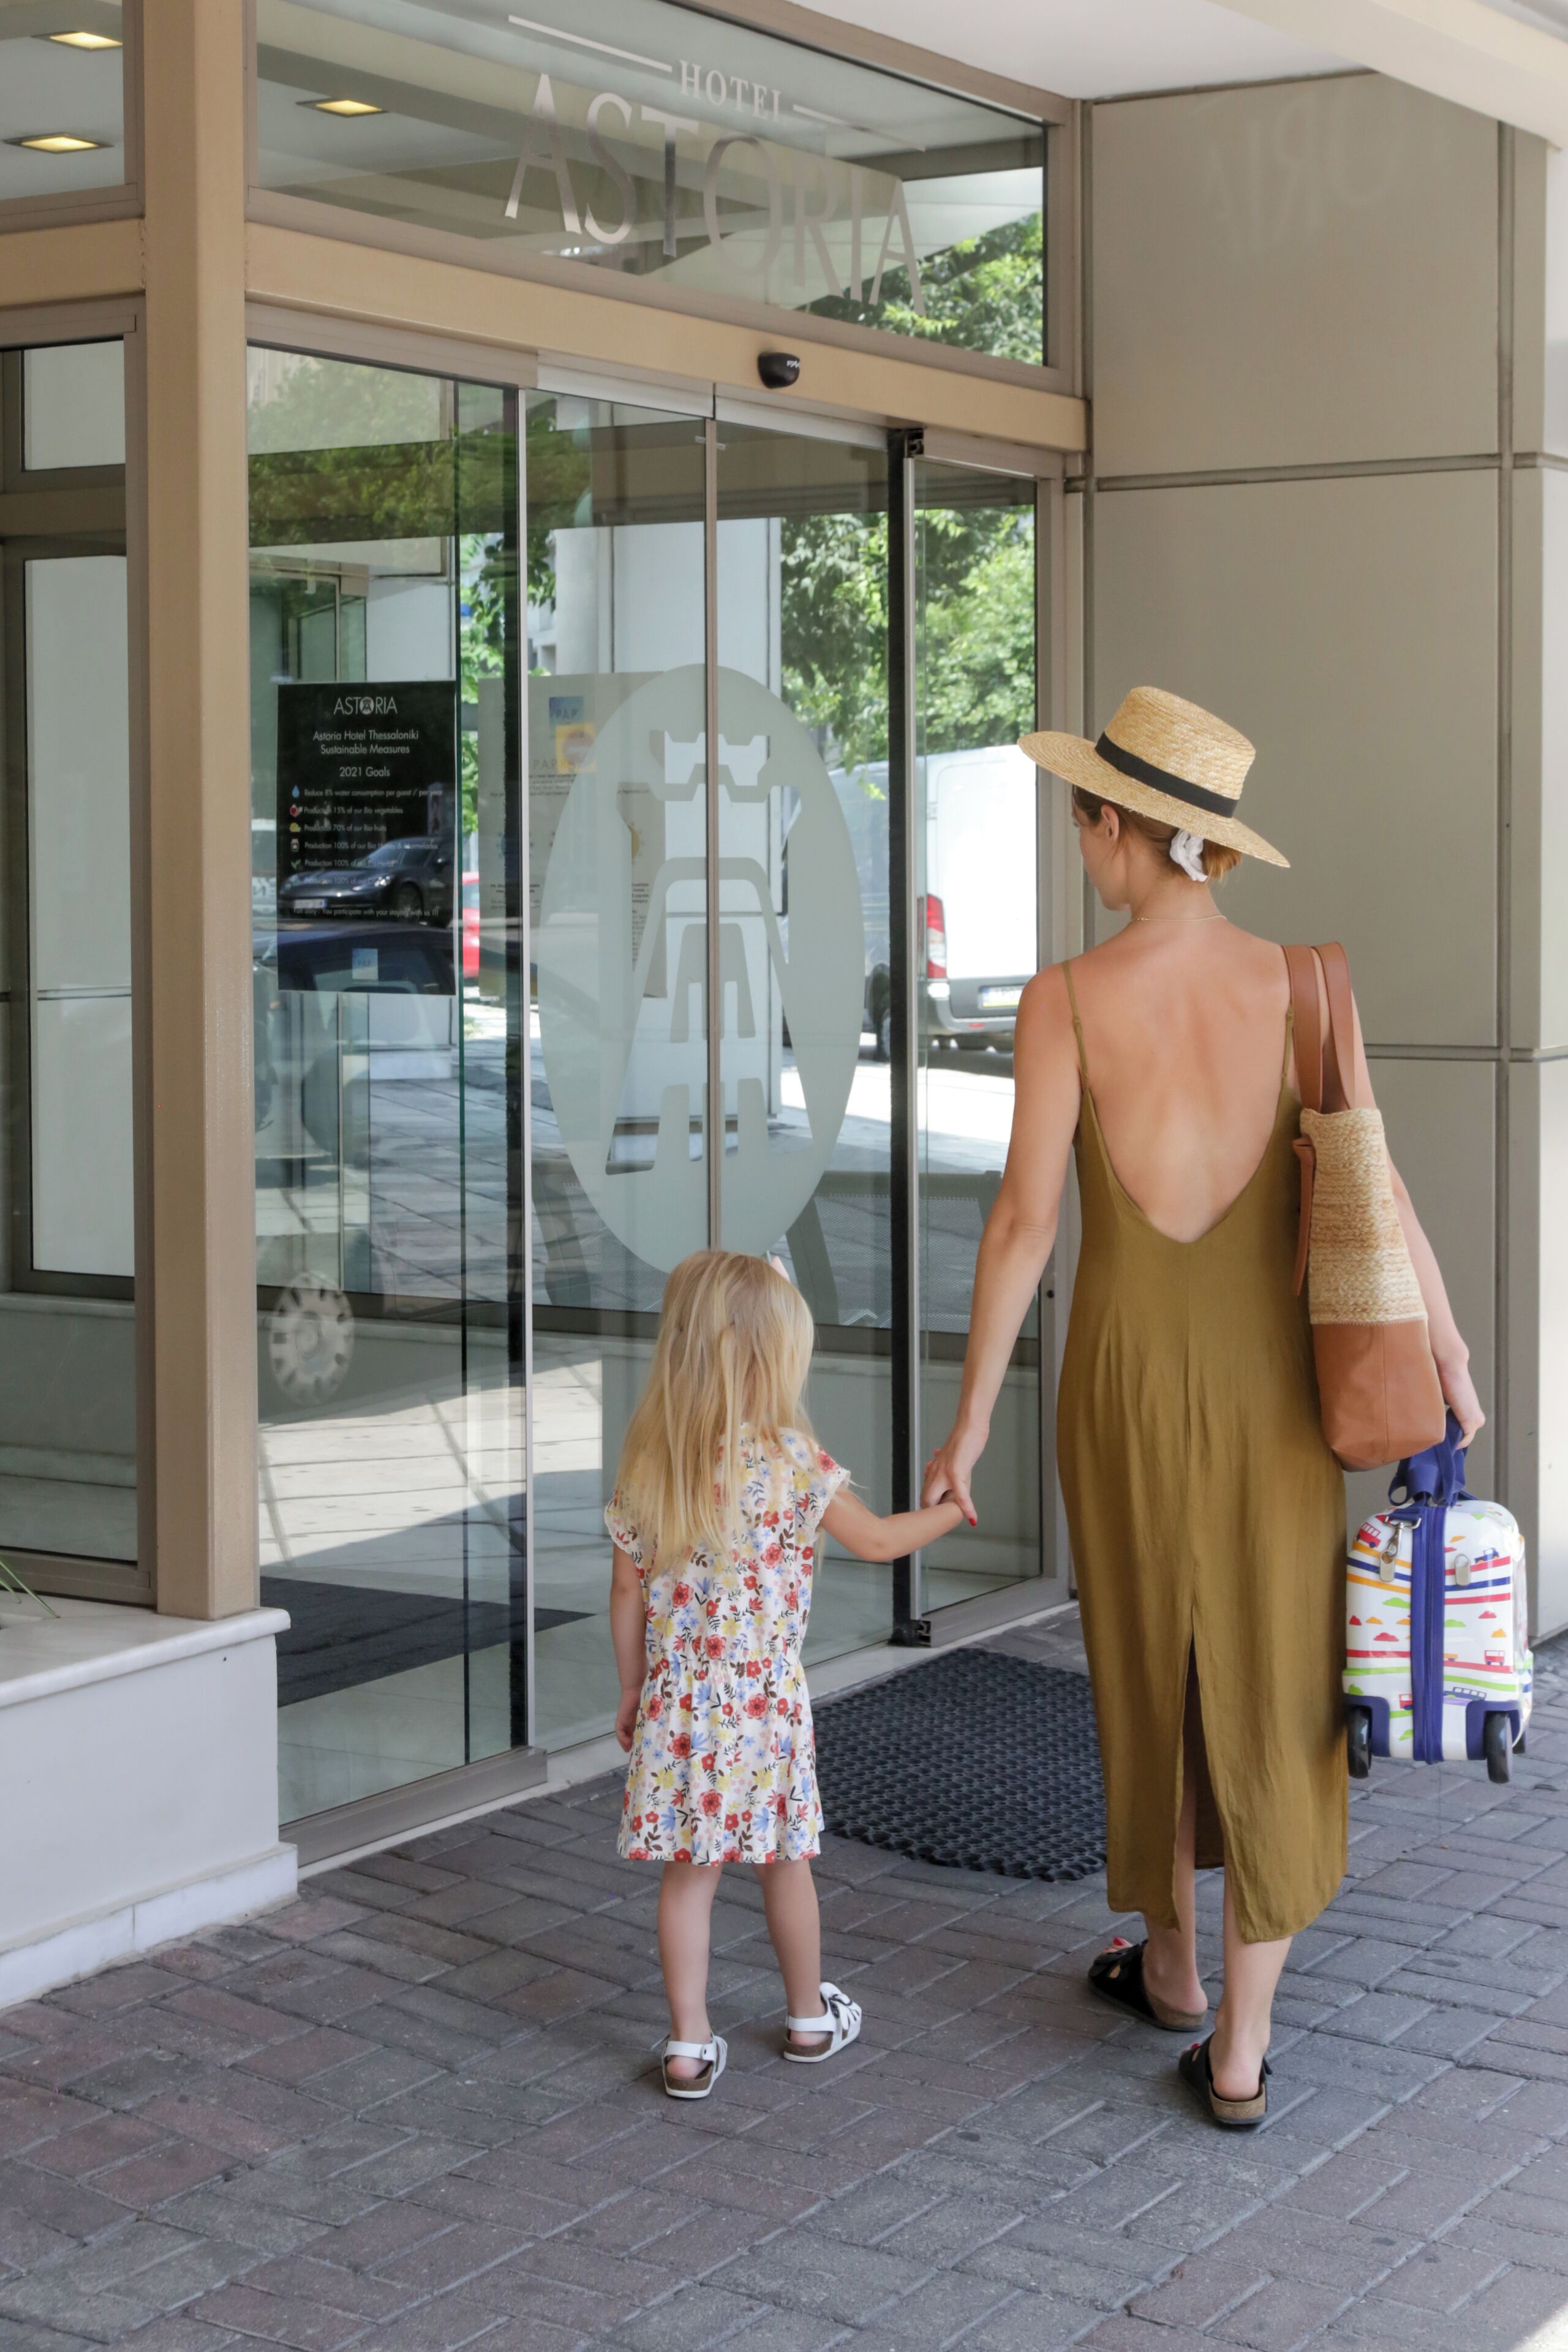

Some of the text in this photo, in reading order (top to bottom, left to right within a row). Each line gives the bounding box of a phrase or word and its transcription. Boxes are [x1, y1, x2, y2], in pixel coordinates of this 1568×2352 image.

[680, 60, 782, 123] HOTEL
[505, 73, 926, 318] ASTORIA
[334, 696, 398, 715] ASTORIA
[313, 728, 419, 741] Astoria Hotel Thessaloniki
[321, 744, 410, 755] Sustainable Measures
[339, 766, 390, 777] 2021 Goals
[352, 790, 385, 798] consumption
[396, 790, 411, 798] guest
[347, 805, 353, 814] of
[364, 805, 373, 814] Bio
[374, 805, 404, 816] vegetables
[347, 823, 353, 832] of
[364, 823, 373, 832] Bio
[304, 841, 332, 850] Production
[350, 841, 356, 850] of
[304, 859, 333, 867] Production
[350, 859, 356, 867] of
[334, 908, 362, 917] participate
